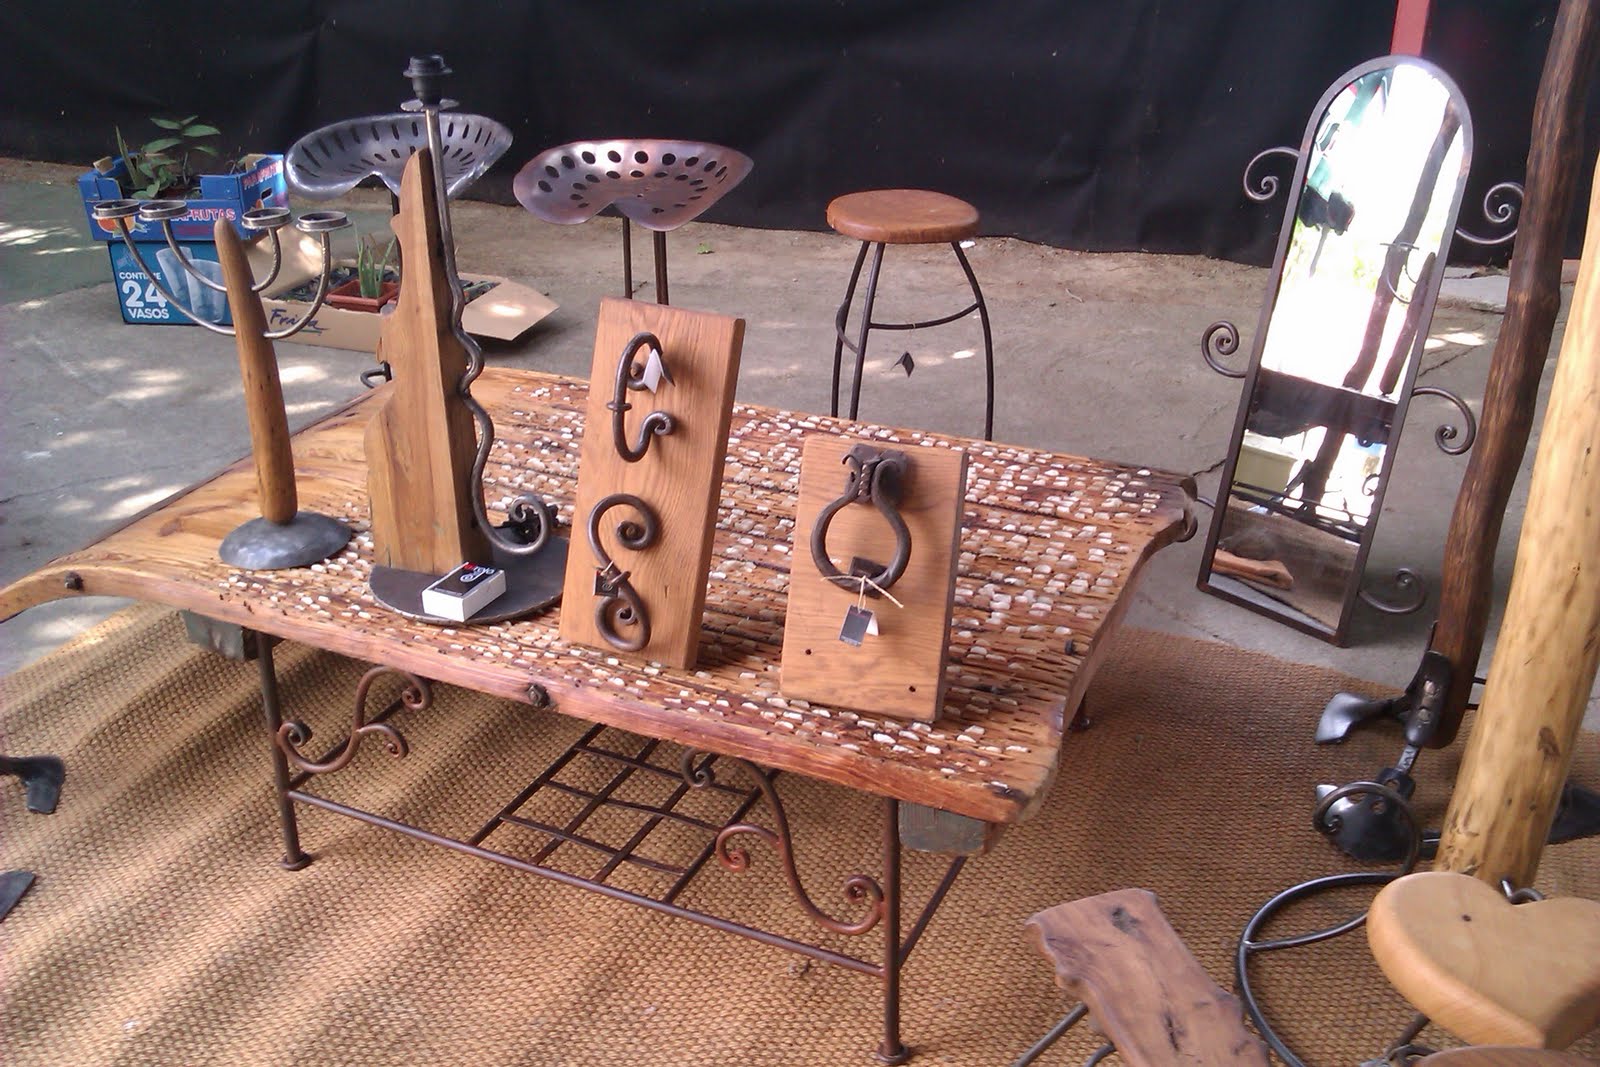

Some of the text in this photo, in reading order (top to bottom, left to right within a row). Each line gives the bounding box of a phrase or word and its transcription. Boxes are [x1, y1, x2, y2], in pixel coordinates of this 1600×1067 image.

[119, 271, 162, 280] CONTIE
[122, 280, 167, 308] 24
[128, 308, 170, 319] VASOS
